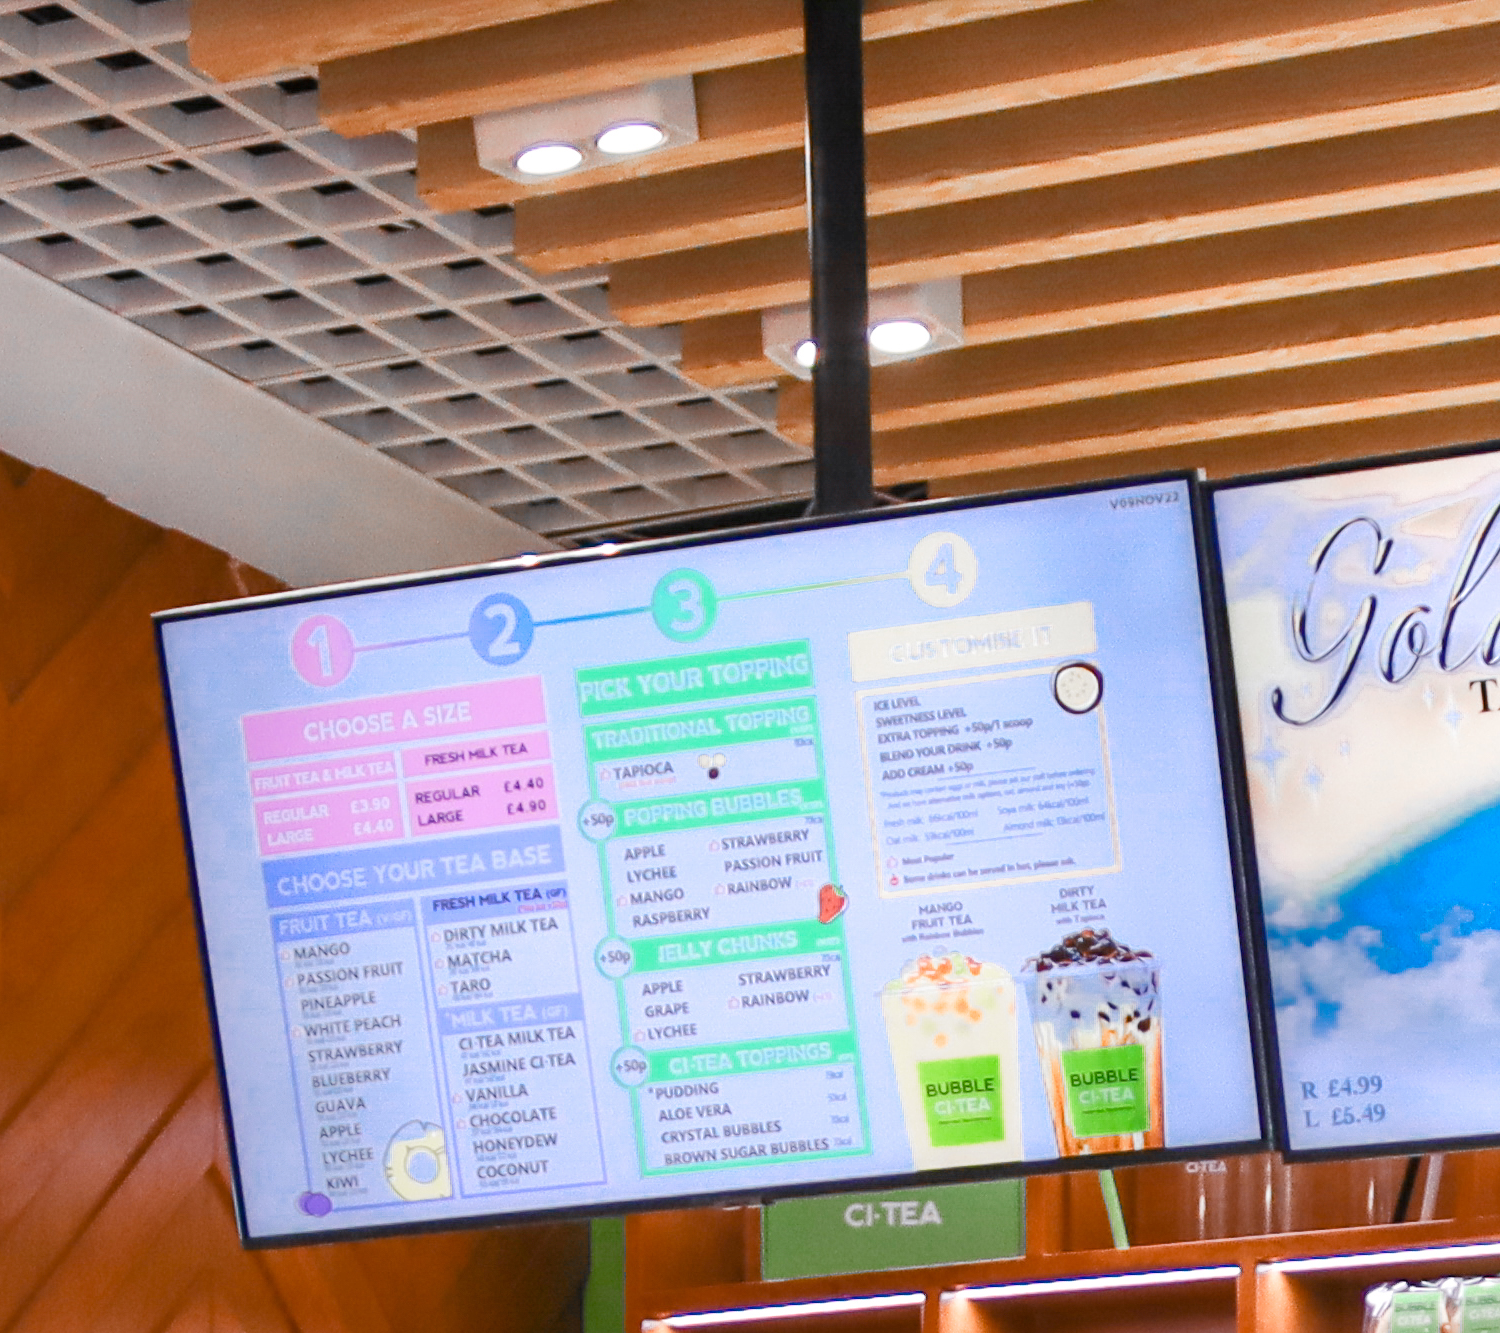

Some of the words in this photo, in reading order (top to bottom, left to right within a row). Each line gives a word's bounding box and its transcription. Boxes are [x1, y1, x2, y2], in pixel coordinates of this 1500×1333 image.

[307, 626, 337, 677] 1
[487, 604, 521, 655] 2
[669, 580, 706, 633] 3
[922, 541, 959, 593] 4
[303, 711, 394, 742] CHOOSE
[402, 709, 418, 729] A
[424, 702, 472, 725] SIZE
[614, 762, 674, 780] TAPIOCA
[415, 786, 480, 803] REGULAR
[504, 778, 544, 793] £4.40
[418, 810, 464, 826] LARGE
[507, 800, 546, 815] £4.90
[721, 829, 809, 850] STRAWBERRY
[276, 868, 367, 896] CHOOSE
[373, 858, 435, 884] YOUR
[440, 852, 485, 874] TEA
[492, 844, 551, 869] BASE
[294, 942, 350, 959] MANGO
[447, 950, 512, 968] MATCHA
[297, 967, 359, 986] PASSION
[363, 962, 403, 977] FRUIT
[451, 978, 491, 993] TARO
[1301, 1081, 1318, 1099] R
[1328, 1075, 1382, 1098] £4.99
[470, 1106, 557, 1129] CHOCOLATE
[1304, 1110, 1320, 1128] L
[1332, 1103, 1386, 1126] £5.49
[477, 1161, 549, 1179] COCONUT
